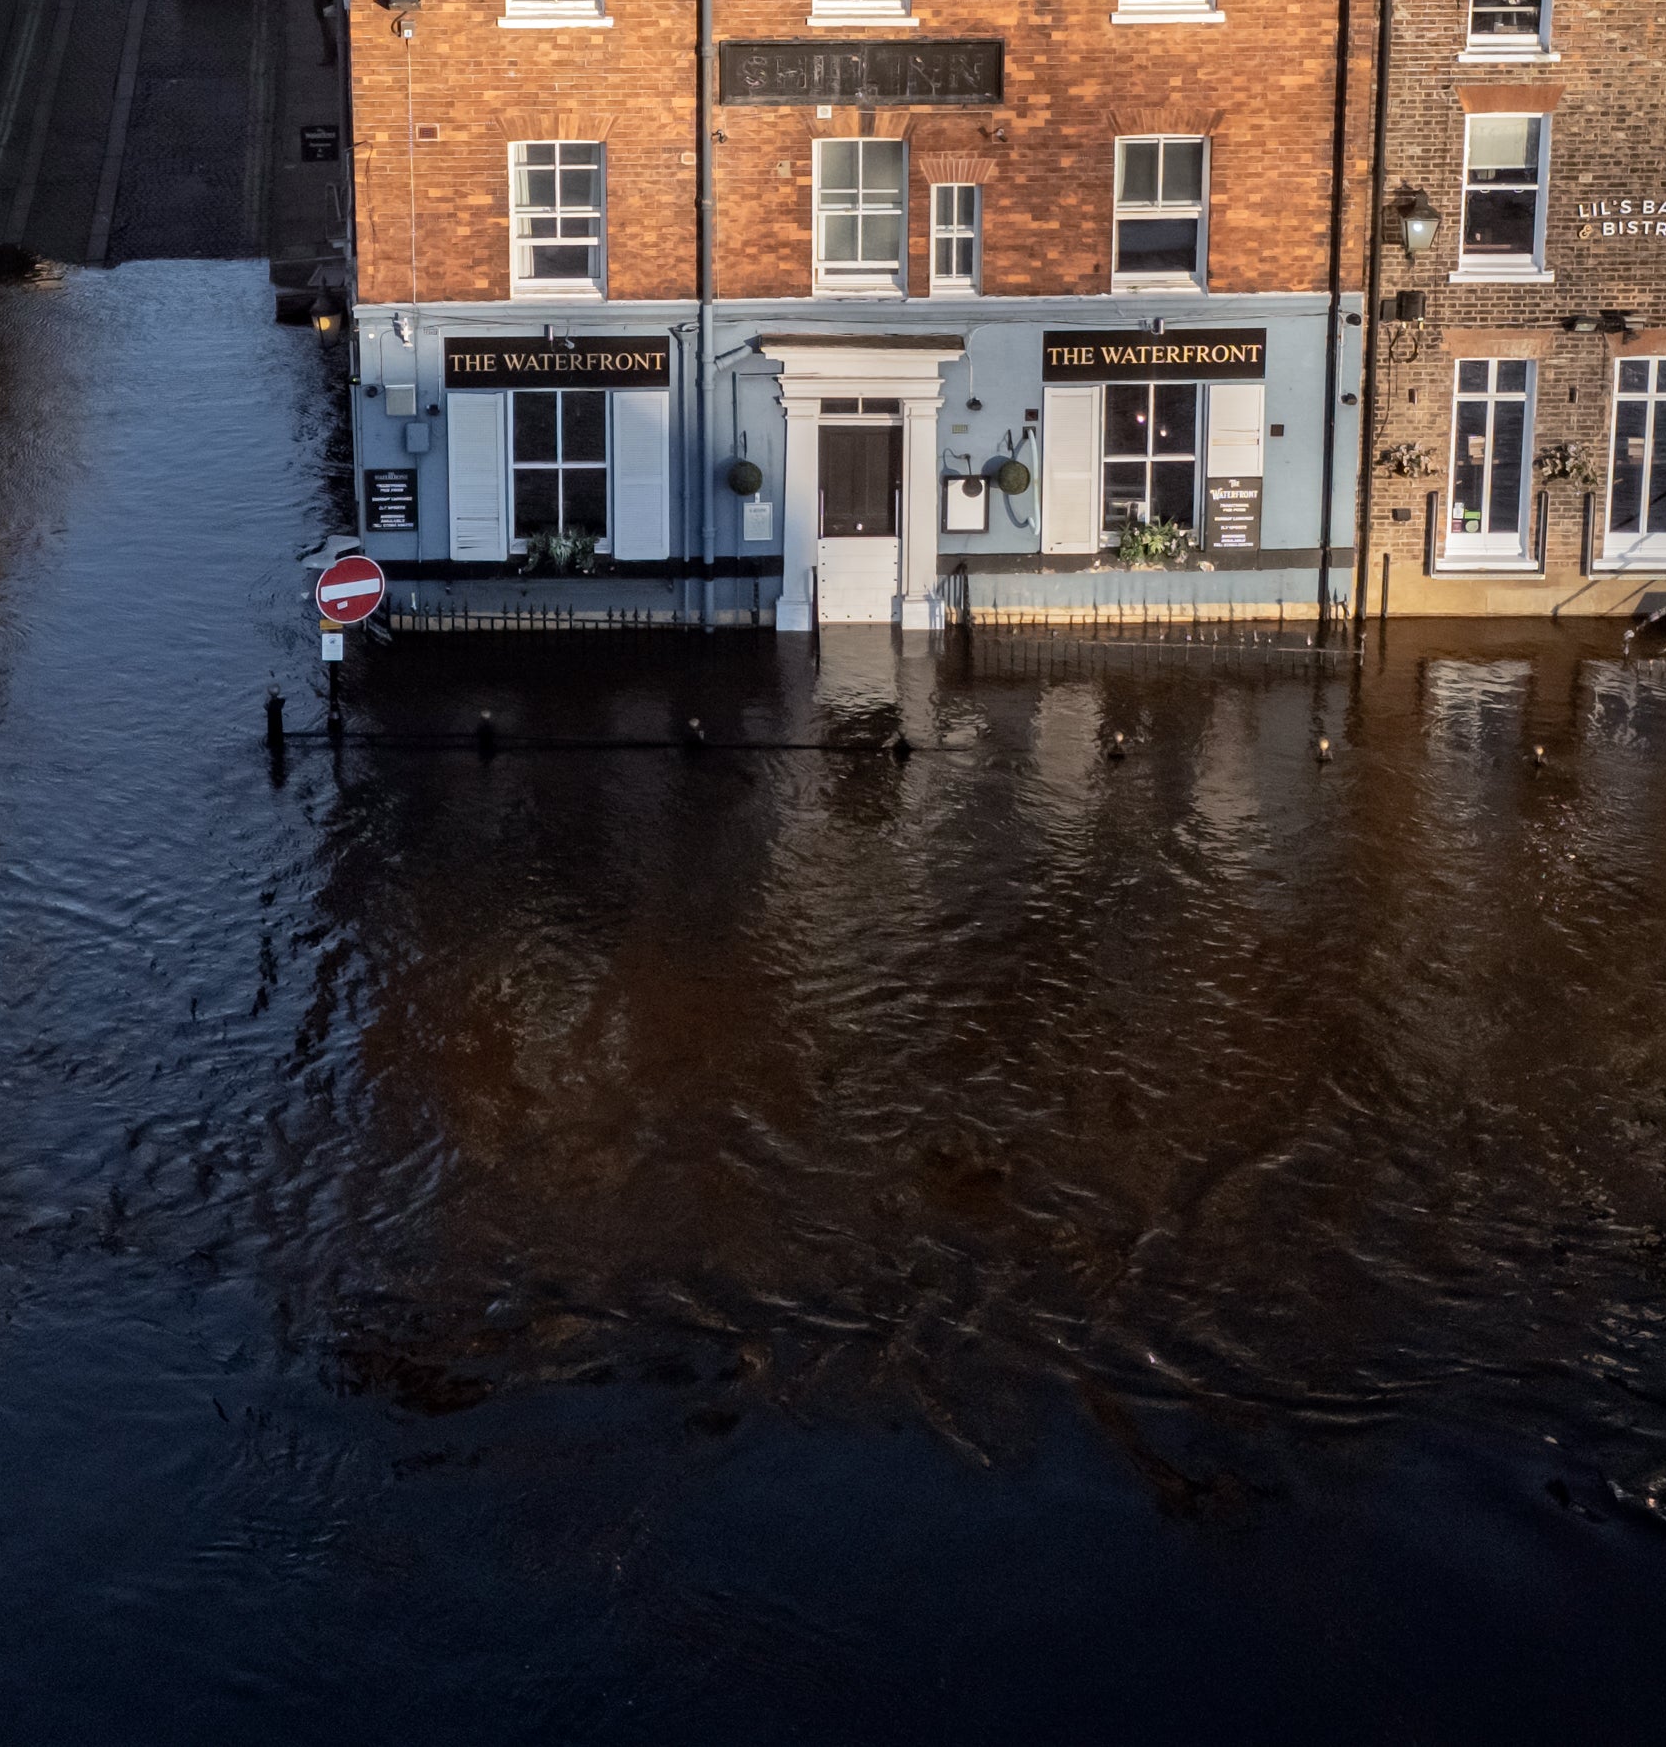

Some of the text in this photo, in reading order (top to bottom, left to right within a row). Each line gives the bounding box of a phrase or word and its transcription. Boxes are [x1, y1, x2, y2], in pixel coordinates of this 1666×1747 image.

[1578, 199, 1632, 218] LIL'S
[1578, 224, 1593, 240] &
[449, 352, 667, 372] THE WATERFRONT
[1047, 344, 1263, 366] THE WATERFRONT
